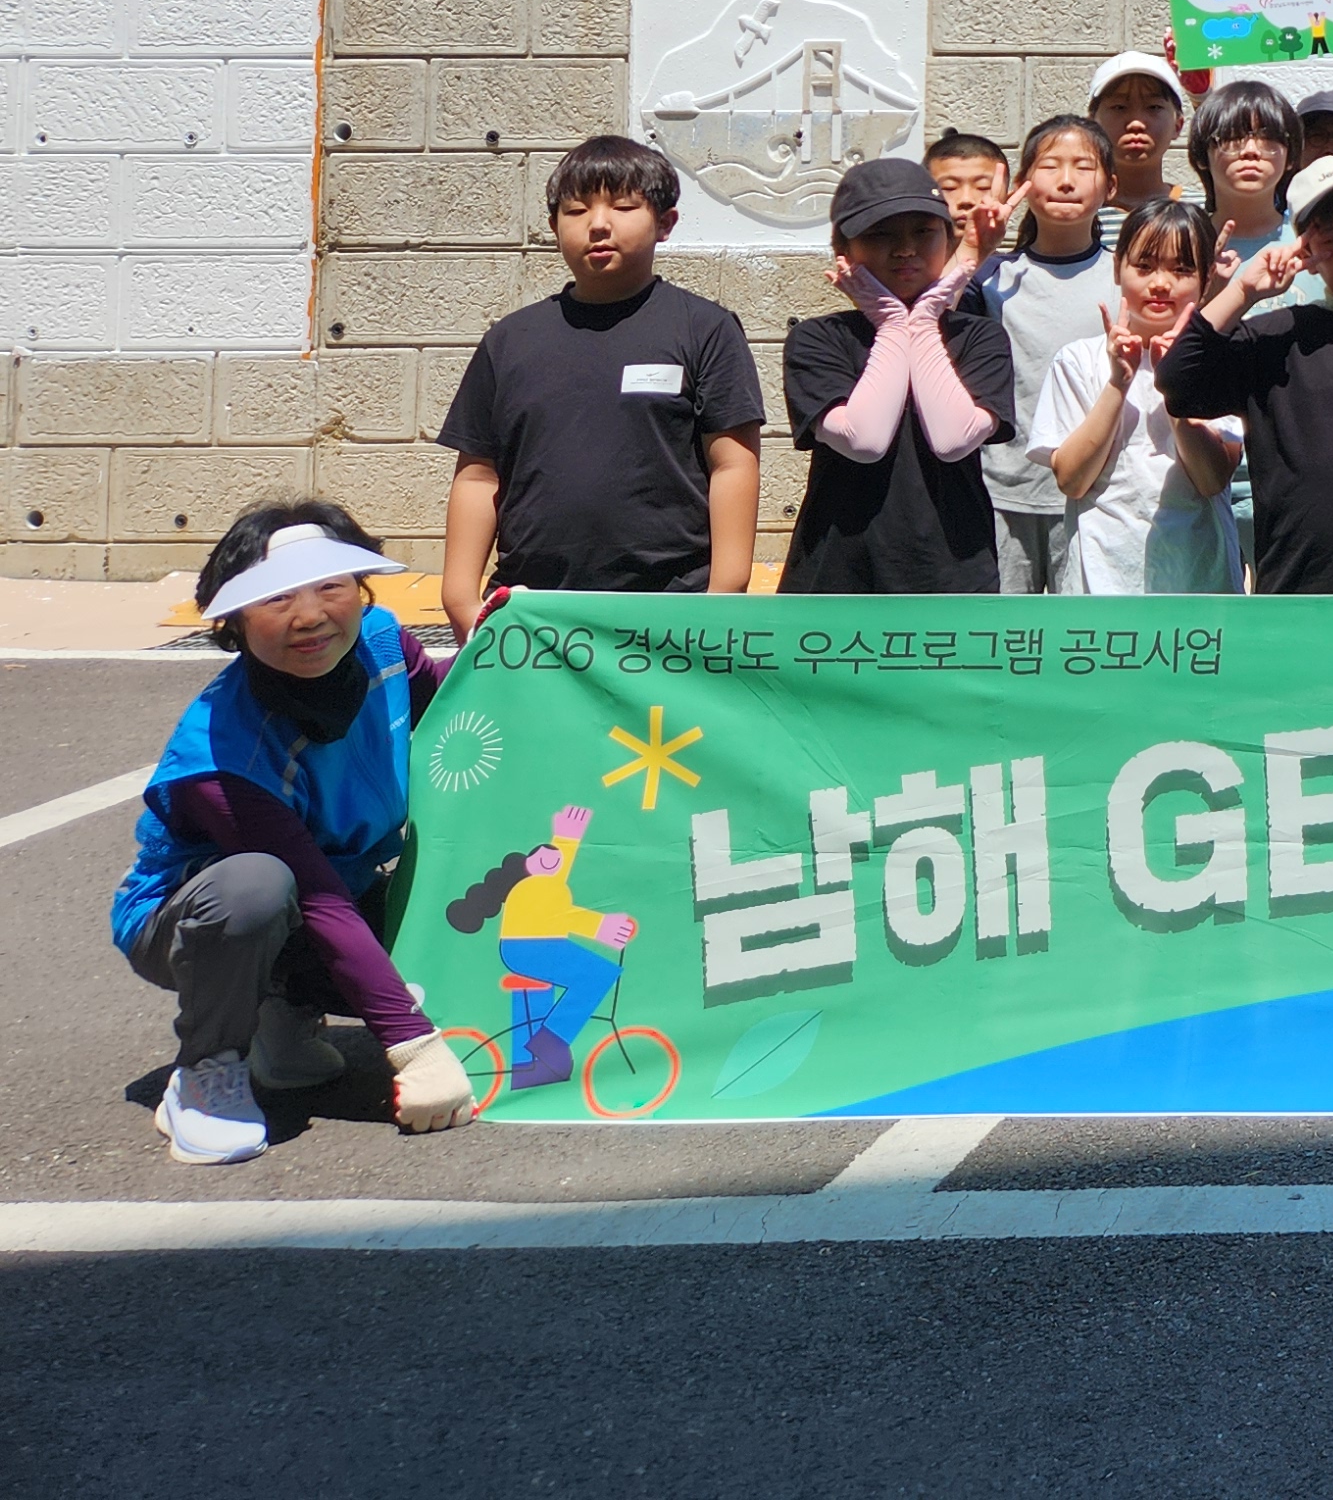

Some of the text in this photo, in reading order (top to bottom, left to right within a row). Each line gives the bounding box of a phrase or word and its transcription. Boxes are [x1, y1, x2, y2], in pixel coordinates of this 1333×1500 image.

[473, 625, 1224, 677] 2026 경상남도 우수프로그램 공모사업
[691, 757, 1051, 1007] 남해
